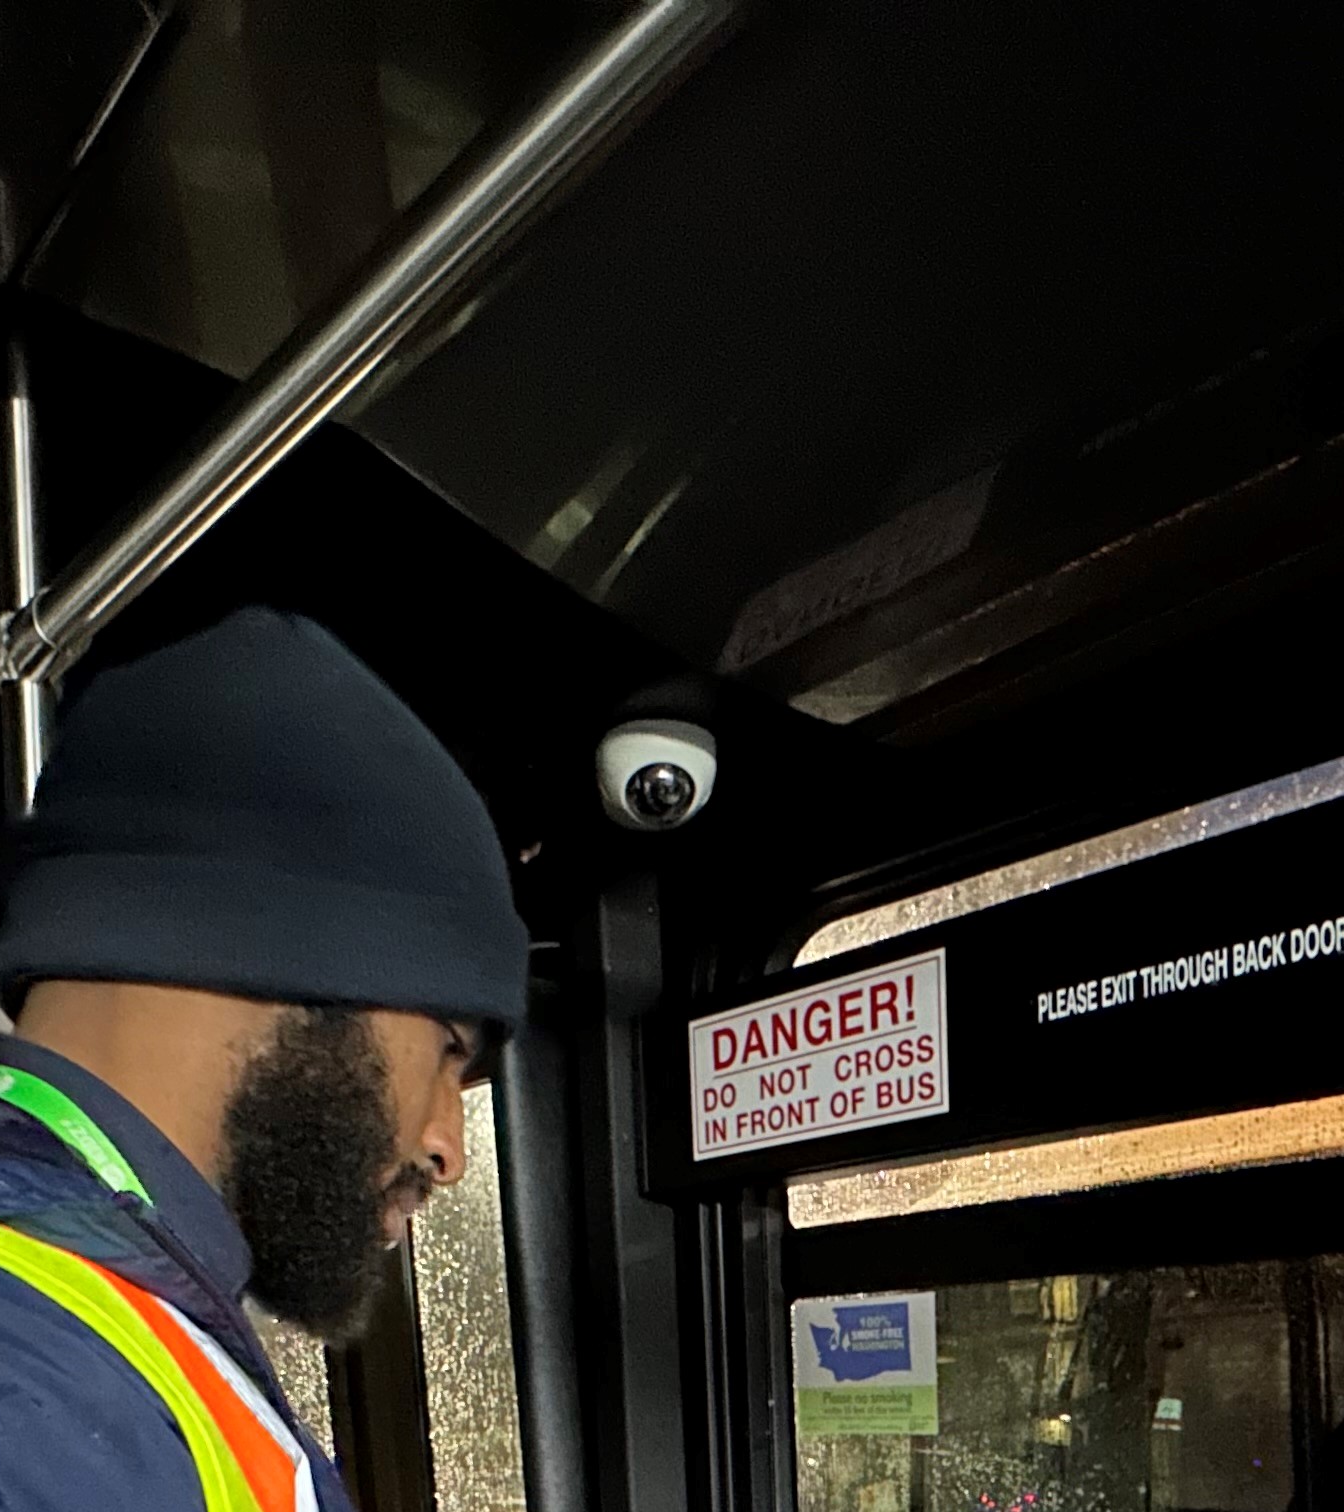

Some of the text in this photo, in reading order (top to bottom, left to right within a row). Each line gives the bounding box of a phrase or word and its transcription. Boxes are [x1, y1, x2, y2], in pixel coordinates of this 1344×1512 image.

[1037, 979, 1098, 1024] PLEASE
[1101, 970, 1137, 1008] EXIT
[1139, 946, 1229, 998] THROUGH
[1232, 932, 1287, 977] BACK
[712, 975, 915, 1072] DANGER!
[704, 1035, 935, 1113] DO NOT CROSS
[705, 1072, 936, 1145] IN FRONT OF BUS
